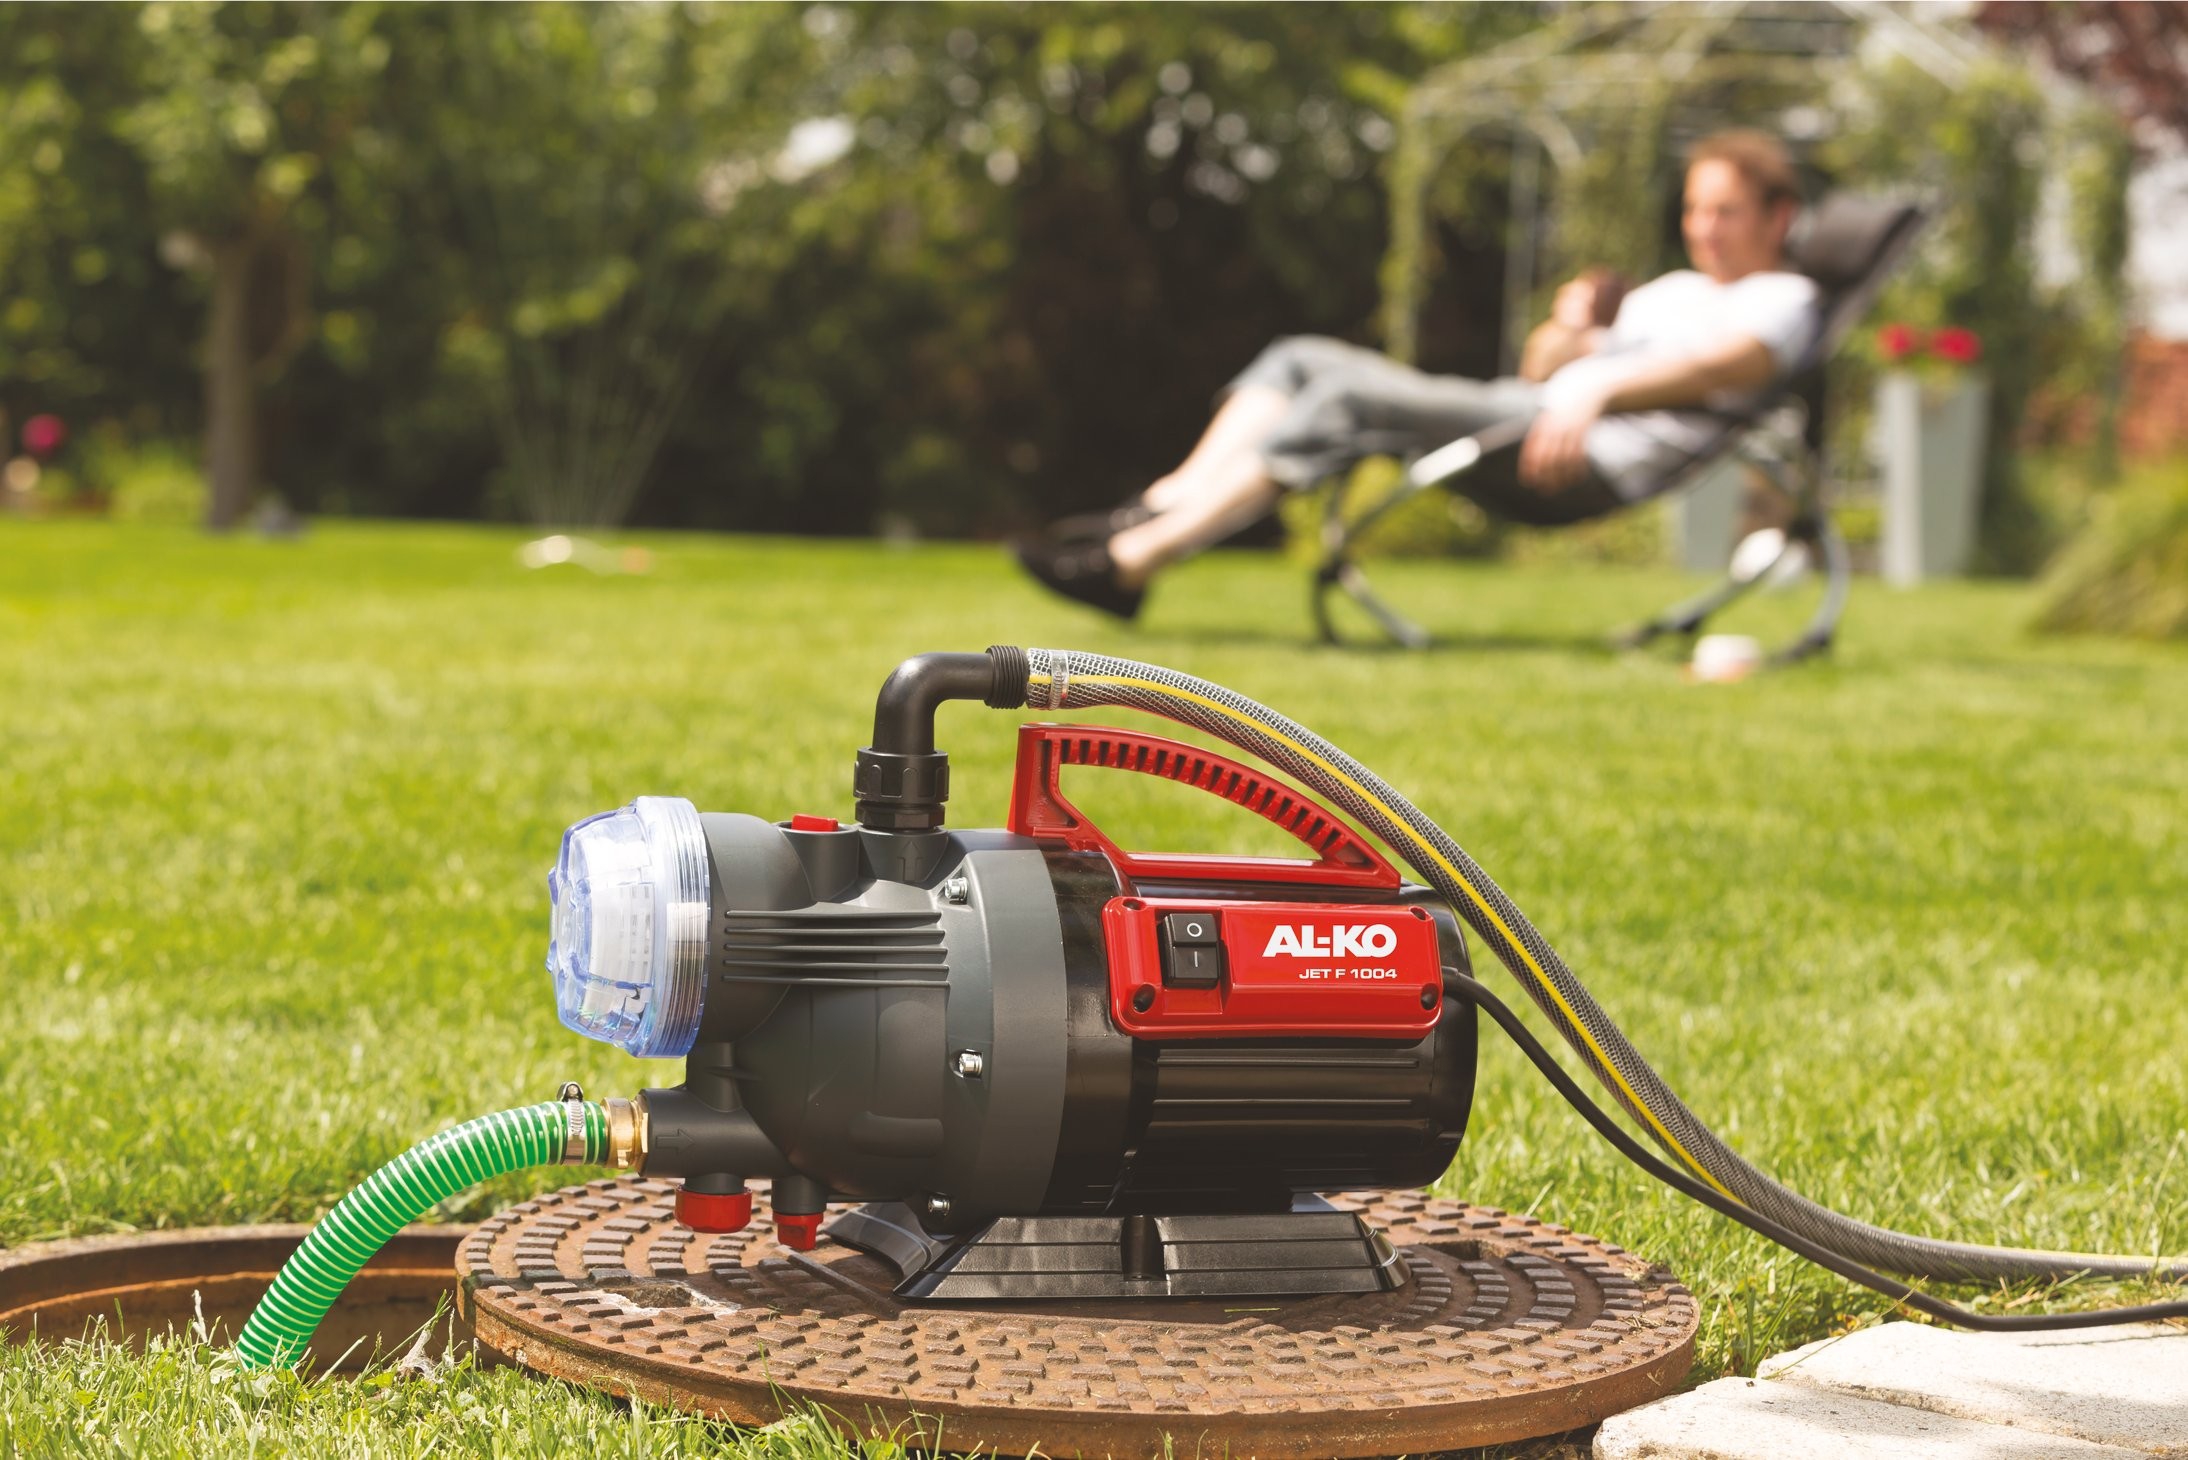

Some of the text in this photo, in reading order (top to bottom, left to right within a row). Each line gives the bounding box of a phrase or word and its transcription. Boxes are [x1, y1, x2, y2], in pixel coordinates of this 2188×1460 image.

[1262, 923, 1398, 958] AL-KO
[1298, 968, 1398, 979] JET F 1004
